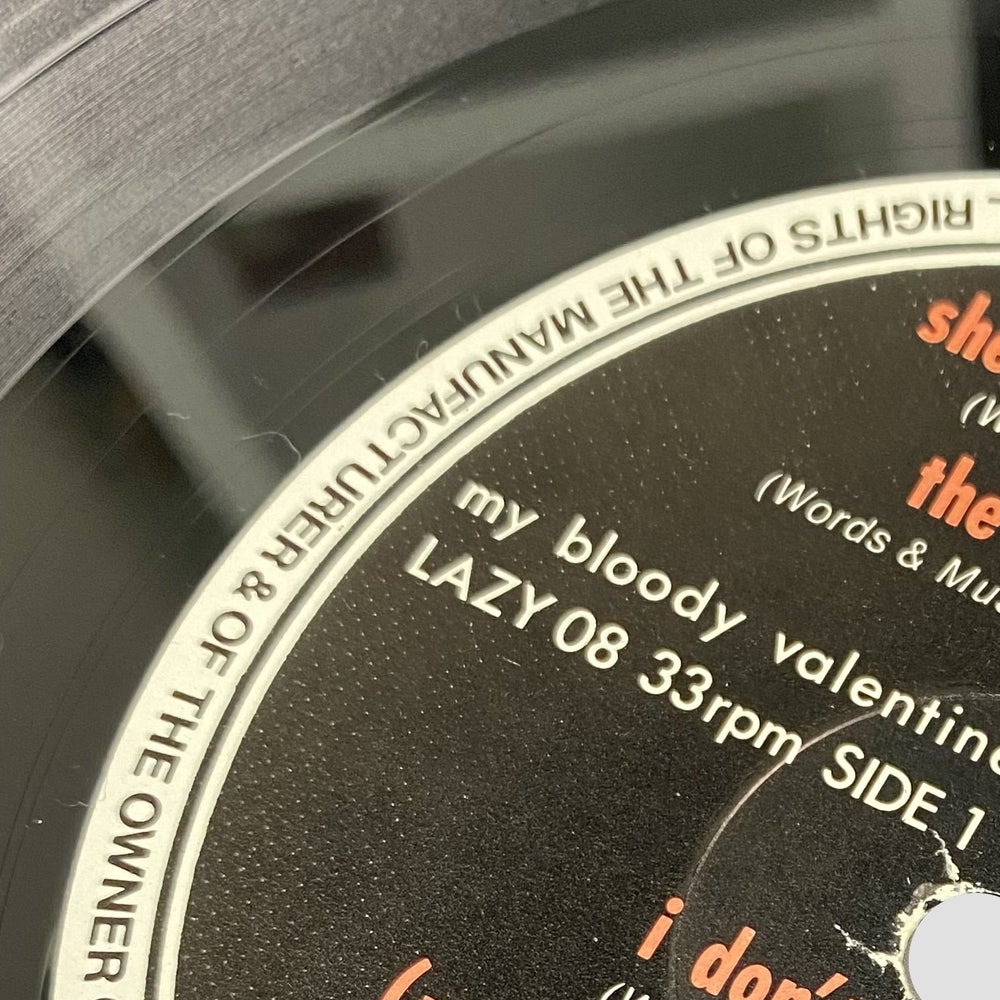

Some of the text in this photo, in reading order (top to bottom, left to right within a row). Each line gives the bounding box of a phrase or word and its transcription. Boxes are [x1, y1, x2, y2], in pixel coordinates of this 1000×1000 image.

[713, 231, 777, 276] OF
[790, 202, 973, 253] RIGHTS
[597, 254, 702, 319] THE
[261, 300, 598, 570] MANUFACTURER
[455, 480, 538, 539] my
[553, 515, 746, 642] bloody
[754, 471, 891, 556] (Words
[896, 538, 929, 571] &
[233, 570, 277, 603] &
[198, 610, 255, 678] OF
[134, 685, 219, 785] THE
[403, 534, 985, 852] LAZY 08 33rpm SIDE 1
[84, 792, 162, 984] OWNER
[637, 897, 684, 960] i
